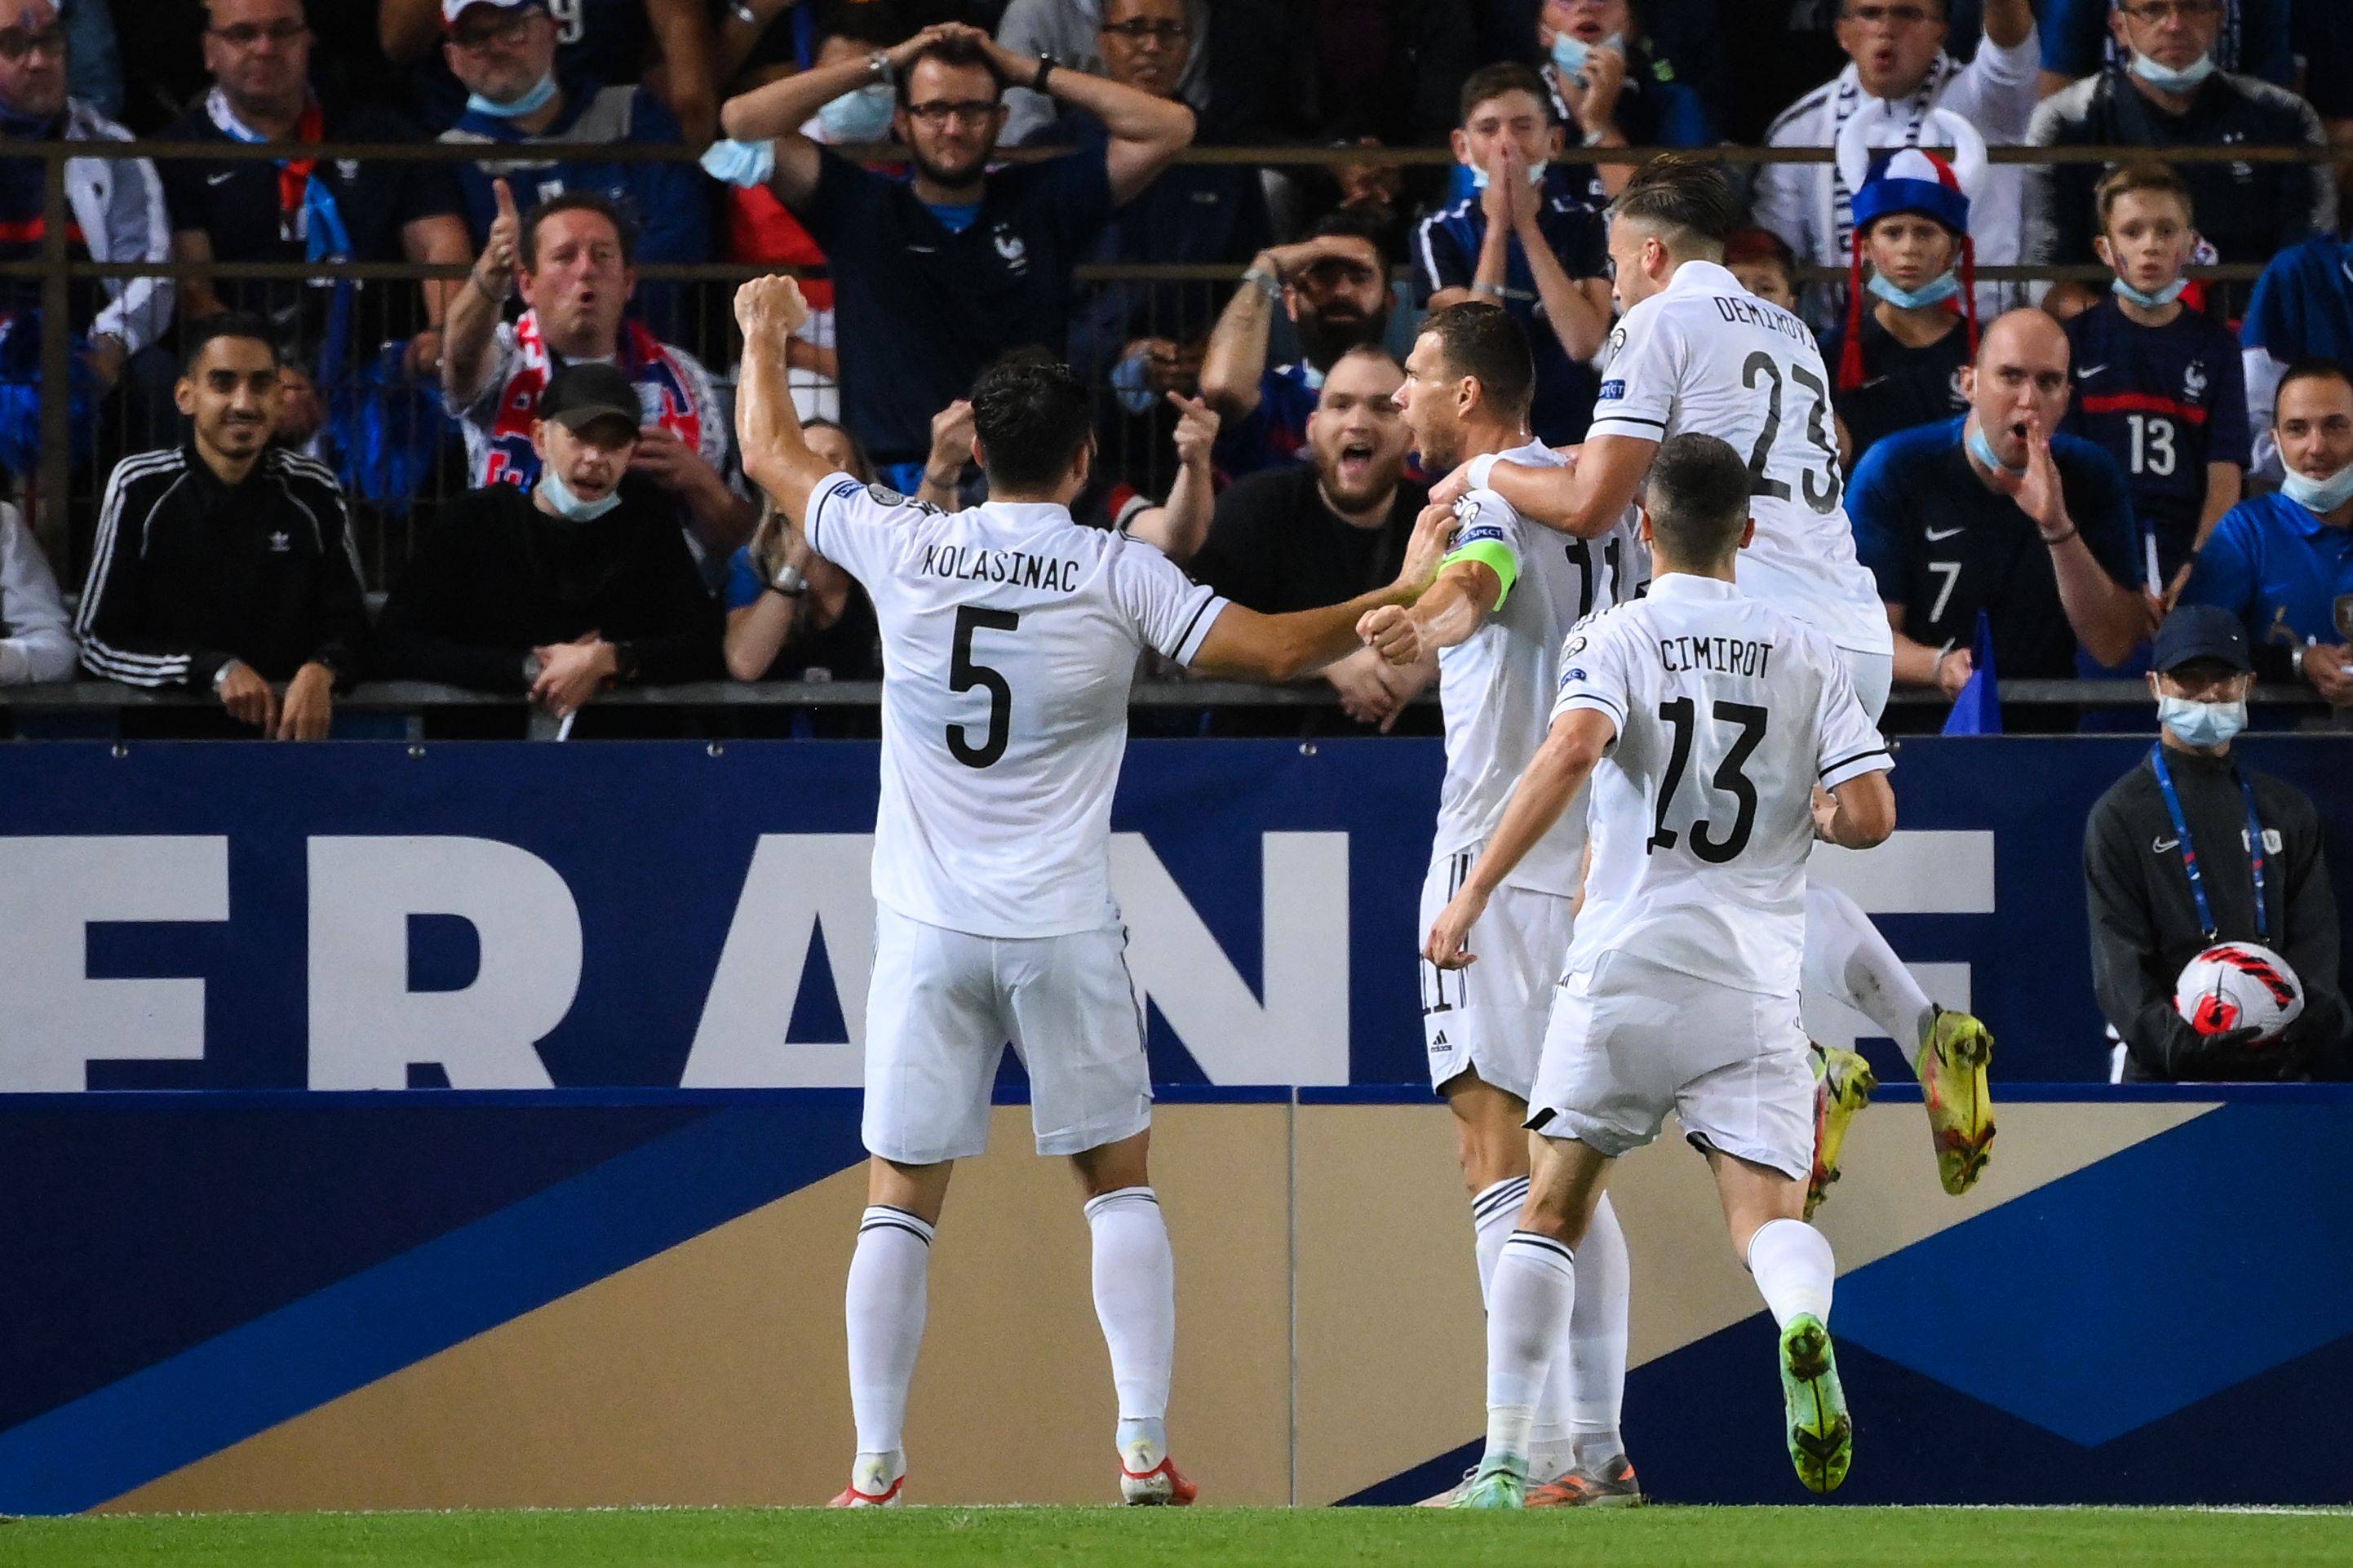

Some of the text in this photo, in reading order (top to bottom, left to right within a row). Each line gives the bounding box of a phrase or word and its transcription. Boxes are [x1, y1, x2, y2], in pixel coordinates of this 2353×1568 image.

[1713, 296, 1818, 352] DEMIROVI
[1742, 350, 1841, 514] 23
[2126, 414, 2176, 476] 13
[1565, 537, 1620, 621] 11
[1928, 561, 1961, 622] 7
[946, 605, 1020, 768] 5
[1660, 636, 1773, 678] CIMIROT
[1646, 696, 1768, 863] 13
